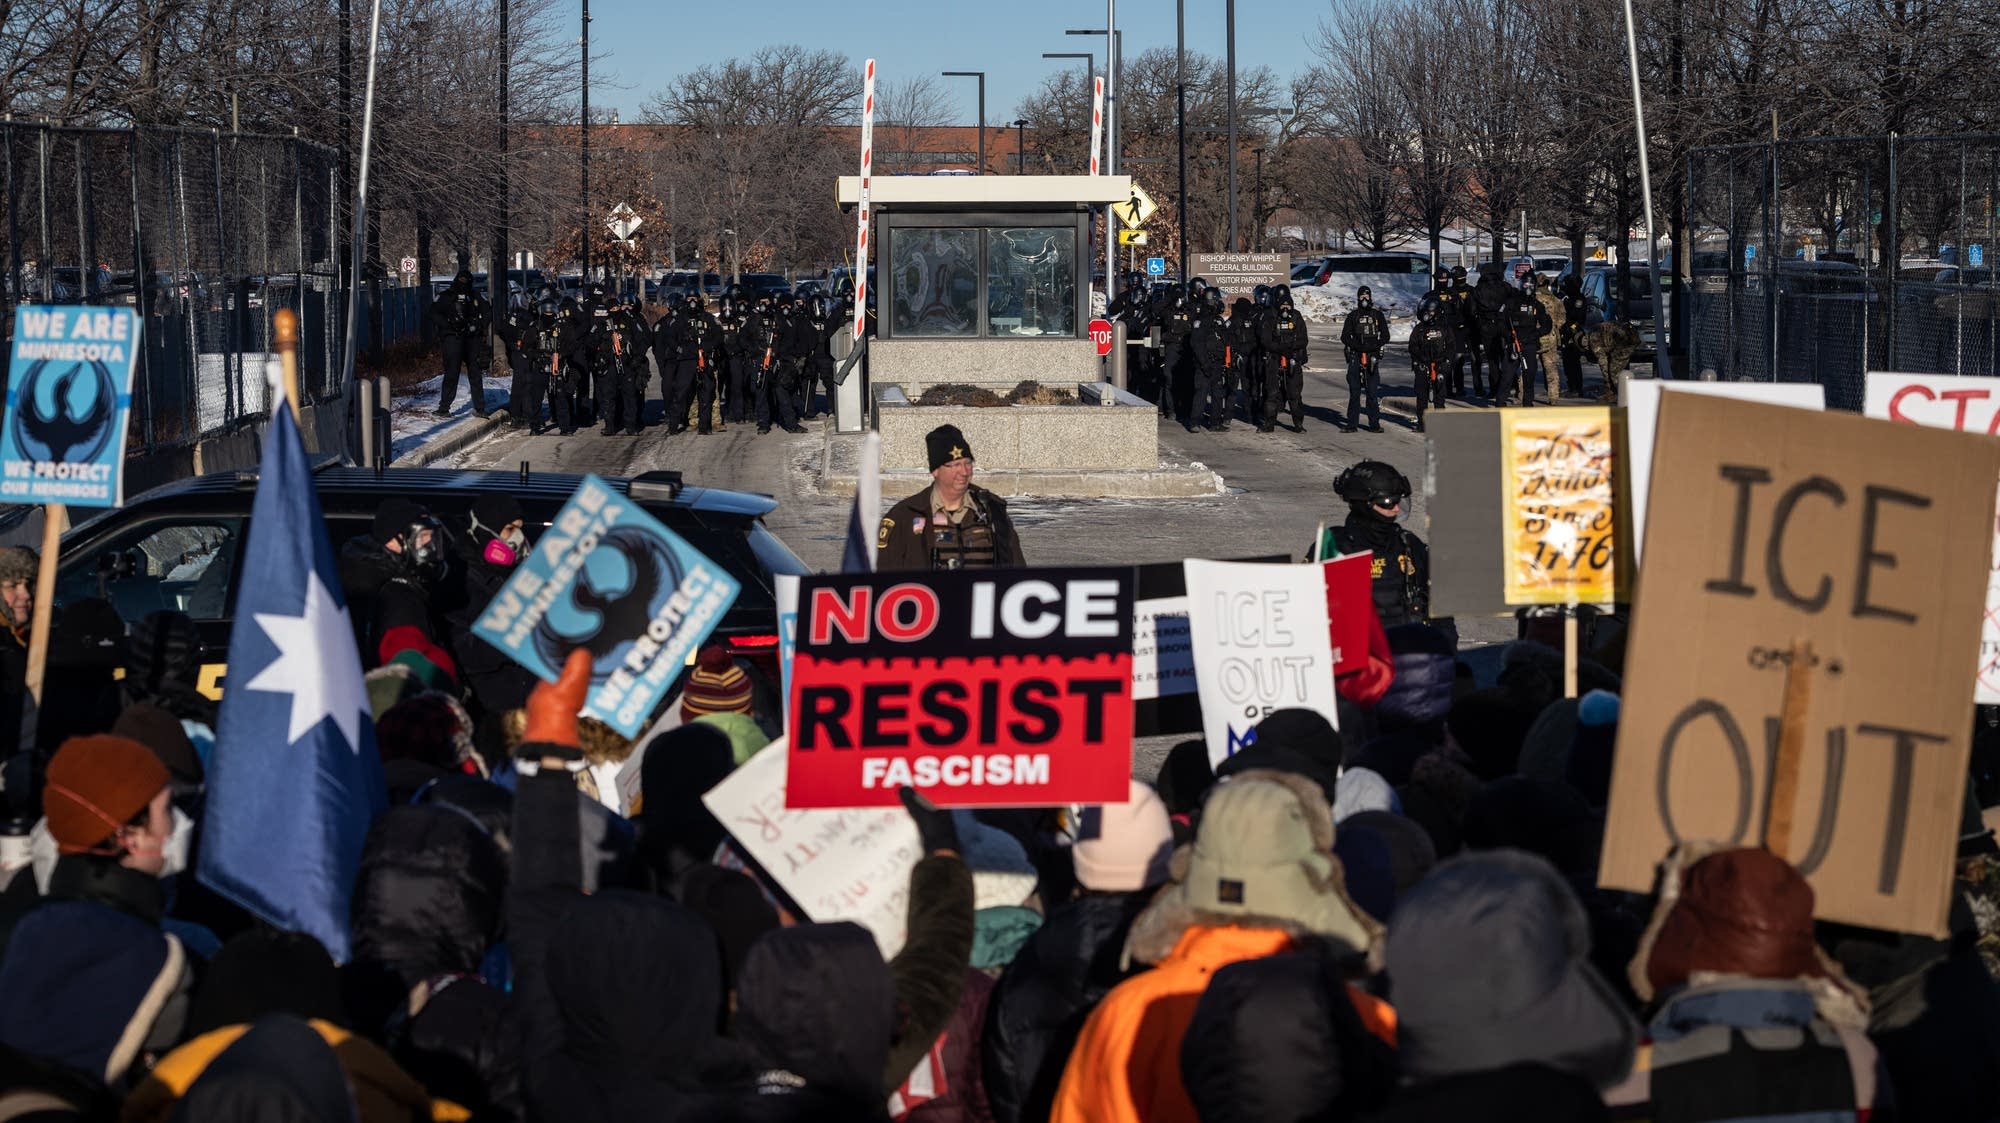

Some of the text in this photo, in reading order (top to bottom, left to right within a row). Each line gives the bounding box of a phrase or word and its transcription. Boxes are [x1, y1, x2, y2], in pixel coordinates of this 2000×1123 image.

[1216, 276, 1268, 284] VISITOR PARKING
[1240, 286, 1253, 294] AND
[18, 341, 124, 363] MINNESOTA
[23, 311, 129, 340] WE ARE
[1, 480, 109, 499] OUR NEIGHBORS
[4, 460, 111, 481] WE PROTECT
[482, 484, 608, 632] WE ARE
[1704, 462, 1933, 625] ICE
[504, 504, 623, 649] MINNESOTA
[594, 565, 713, 712] WE PROTECT
[809, 582, 940, 646] NO
[970, 579, 1120, 640] ICE
[1215, 589, 1295, 649] ICE
[616, 578, 732, 726] OUR NEIGHBORS
[1218, 655, 1315, 706] OUT
[797, 678, 1123, 750] RESIST
[861, 753, 1051, 789] FASCISM
[1656, 698, 1953, 896] OUT
